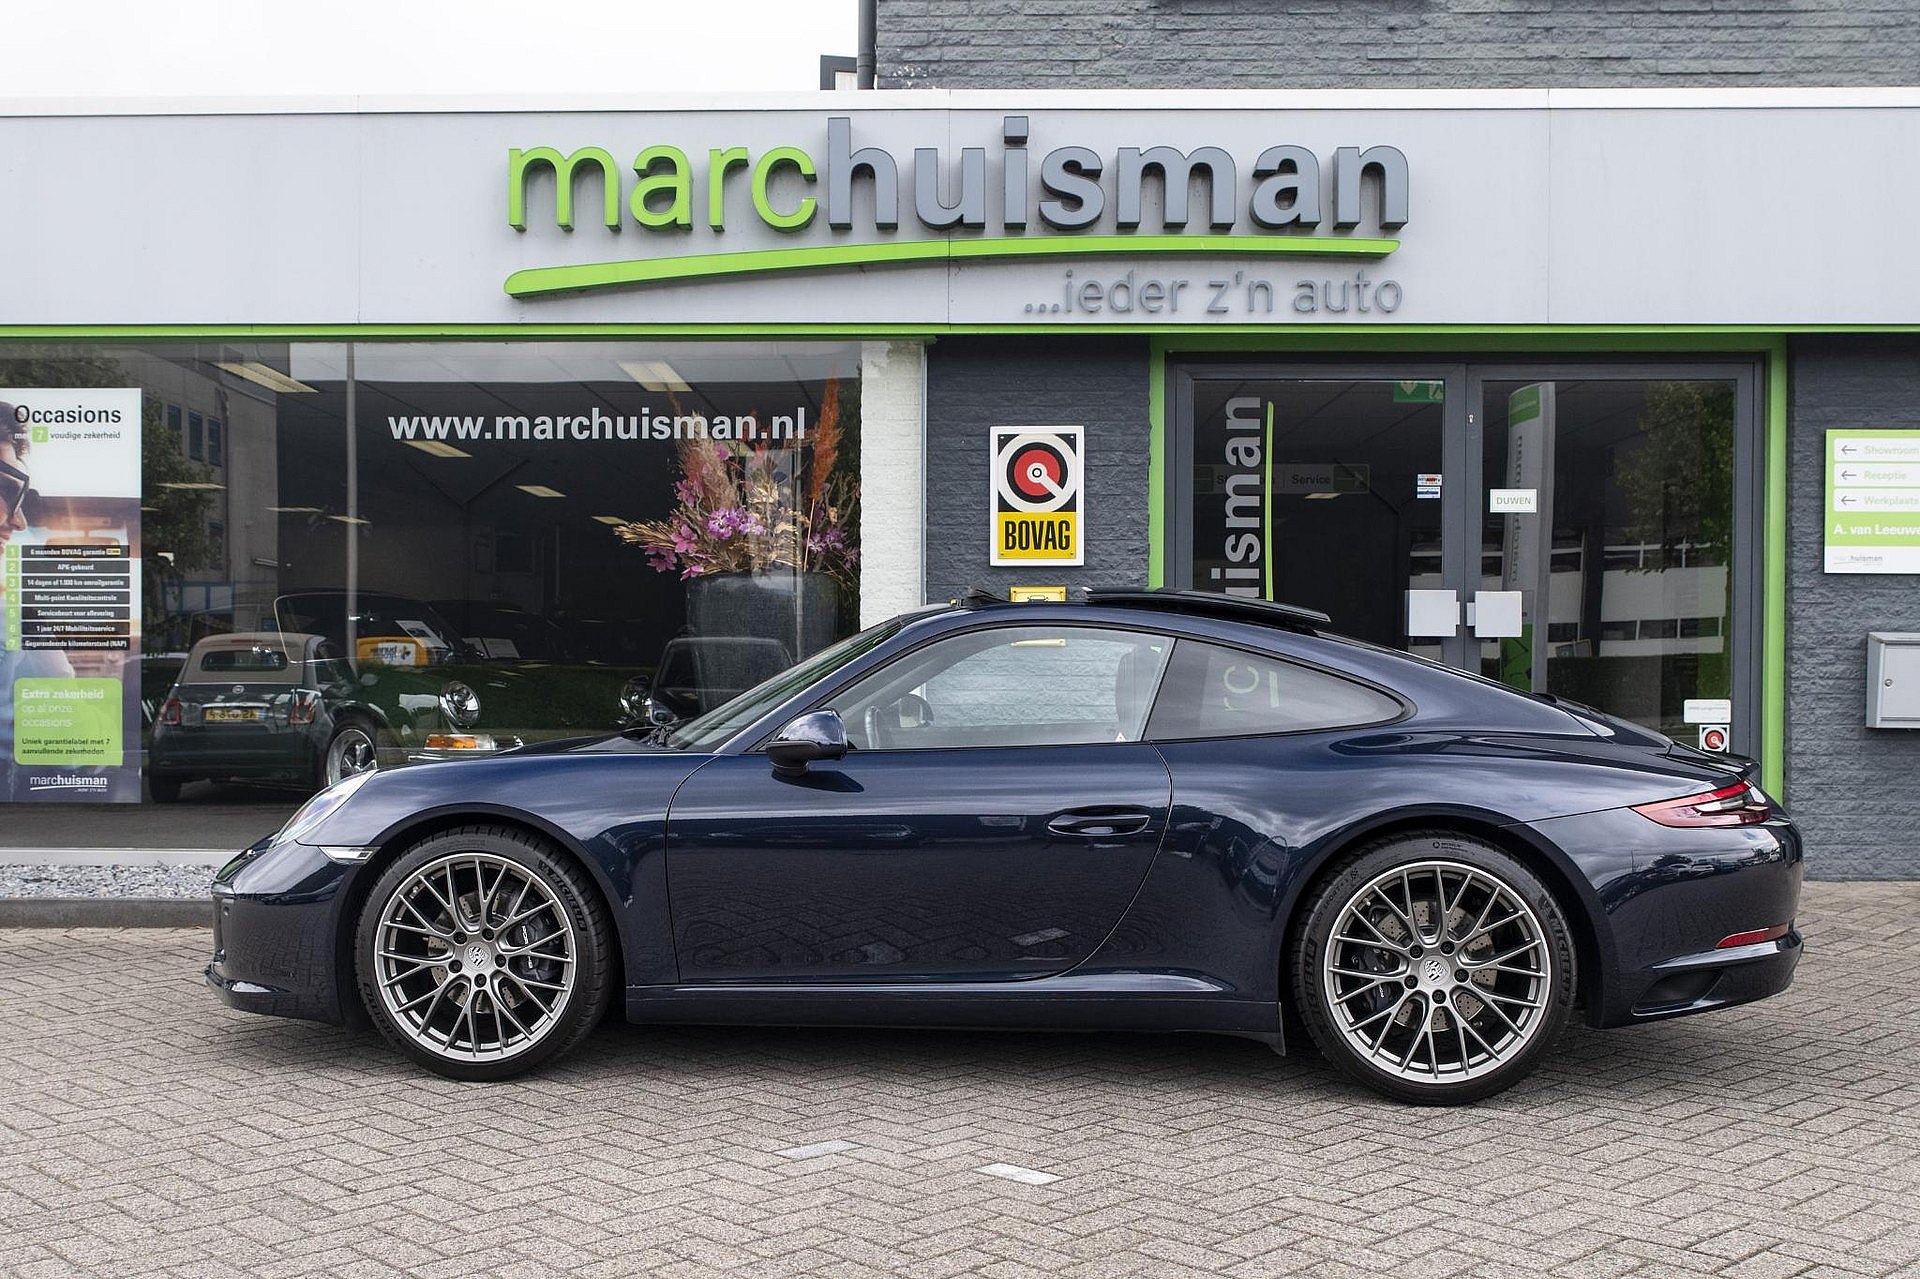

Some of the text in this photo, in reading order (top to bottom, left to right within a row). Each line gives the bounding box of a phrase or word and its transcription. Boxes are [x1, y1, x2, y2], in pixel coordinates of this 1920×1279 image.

[507, 116, 1410, 232] marchuisman
[1024, 269, 1403, 314] ...ieder z'n auto
[15, 405, 121, 423] Occasions
[388, 407, 806, 440] www.marchuisman.nl
[51, 431, 81, 440] voudige
[84, 431, 120, 439] zekerheid
[1496, 496, 1532, 505] DUWEN
[1004, 520, 1070, 551] BOVAG
[1850, 526, 1872, 535] van
[30, 774, 108, 785] marchuisman
